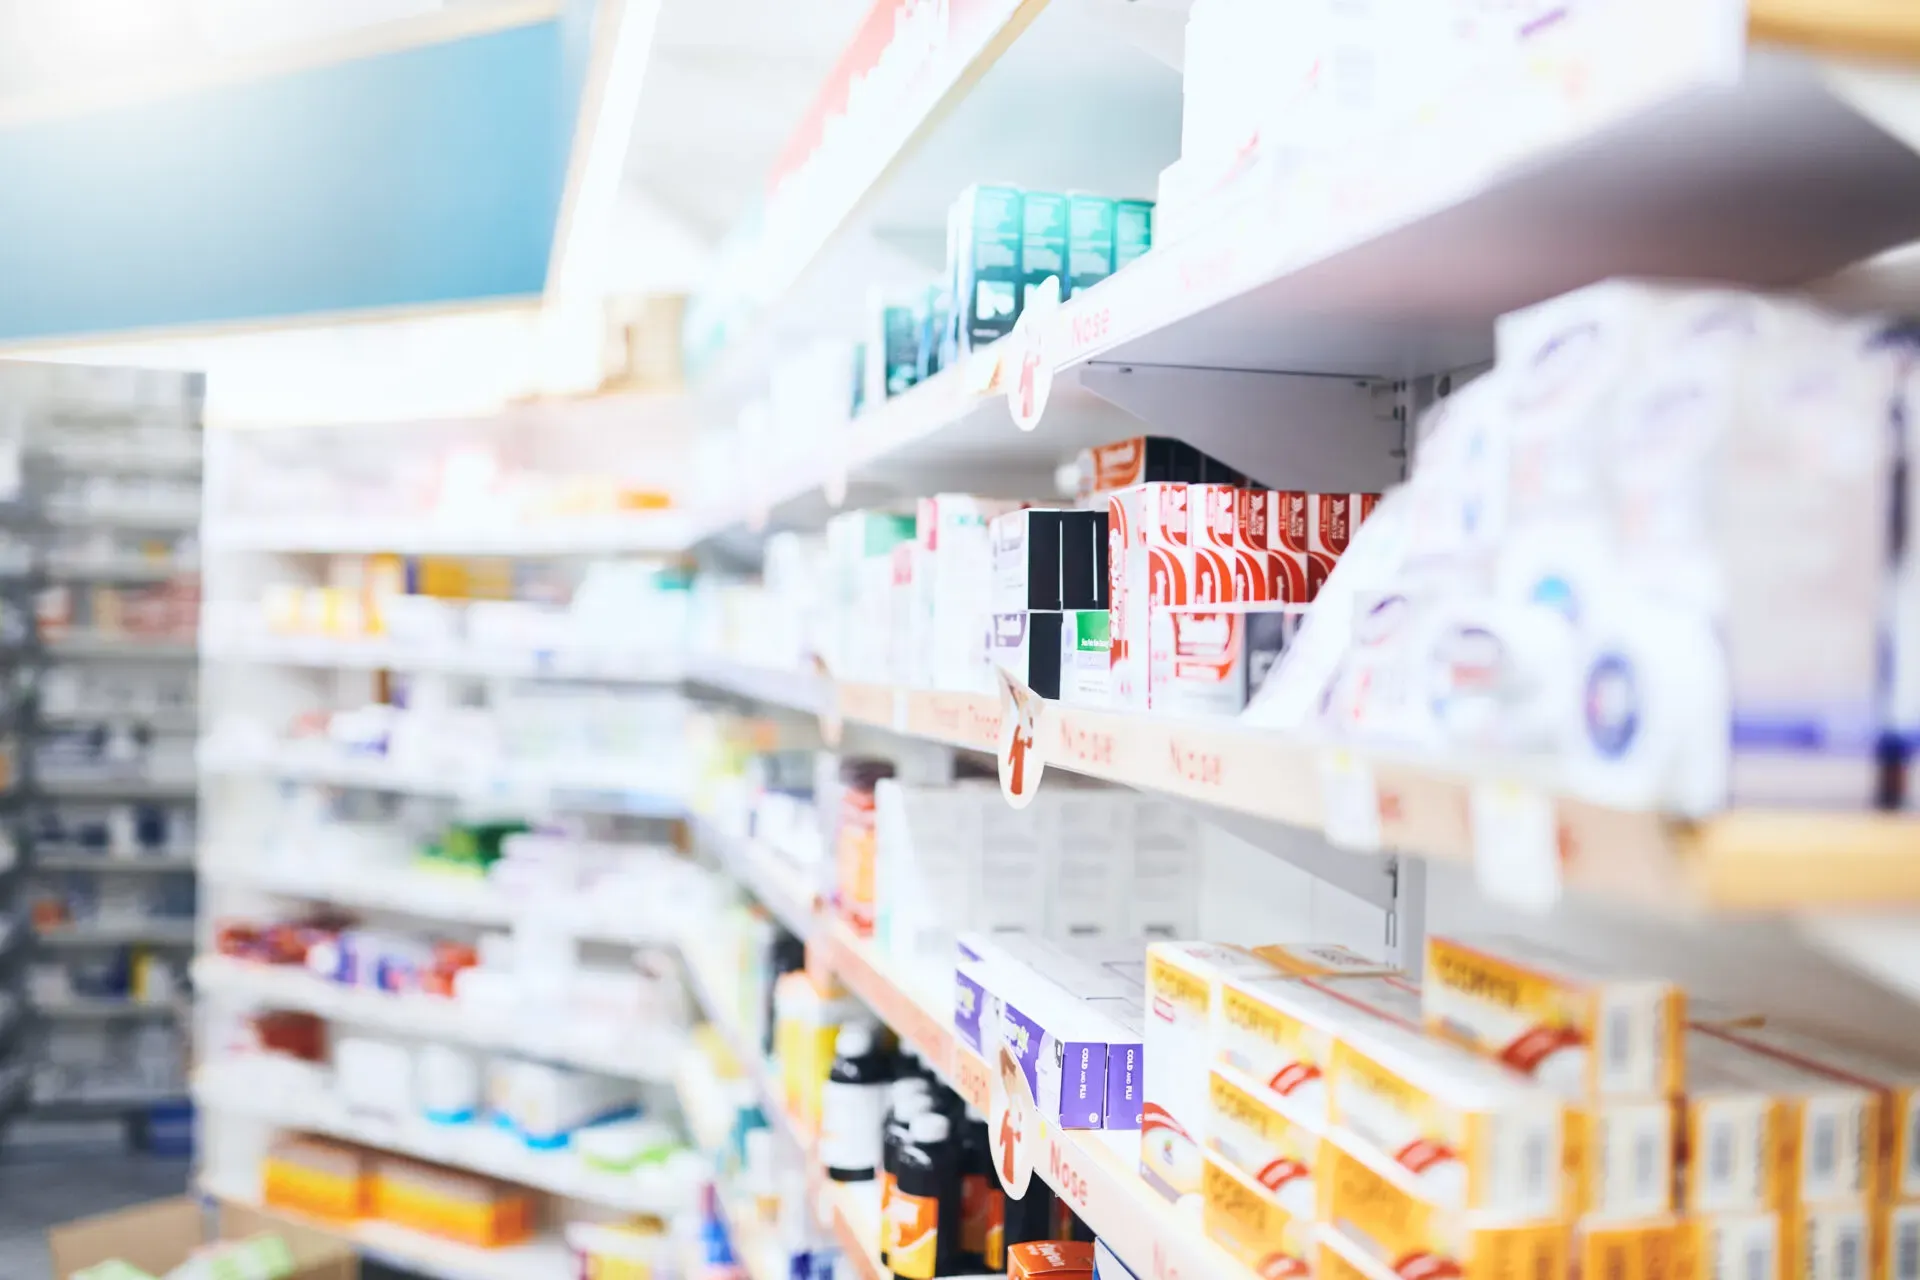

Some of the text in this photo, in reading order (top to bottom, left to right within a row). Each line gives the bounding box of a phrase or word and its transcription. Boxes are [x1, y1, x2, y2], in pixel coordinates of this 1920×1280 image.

[1071, 308, 1110, 348] Nose
[1060, 717, 1113, 767] Nose
[1169, 737, 1222, 786] Nose
[1081, 1047, 1089, 1070] COLD
[1126, 1049, 1134, 1071] COLD
[1079, 1084, 1087, 1099] FLU
[1125, 1085, 1133, 1100] FLU
[1049, 1139, 1087, 1207] Nose
